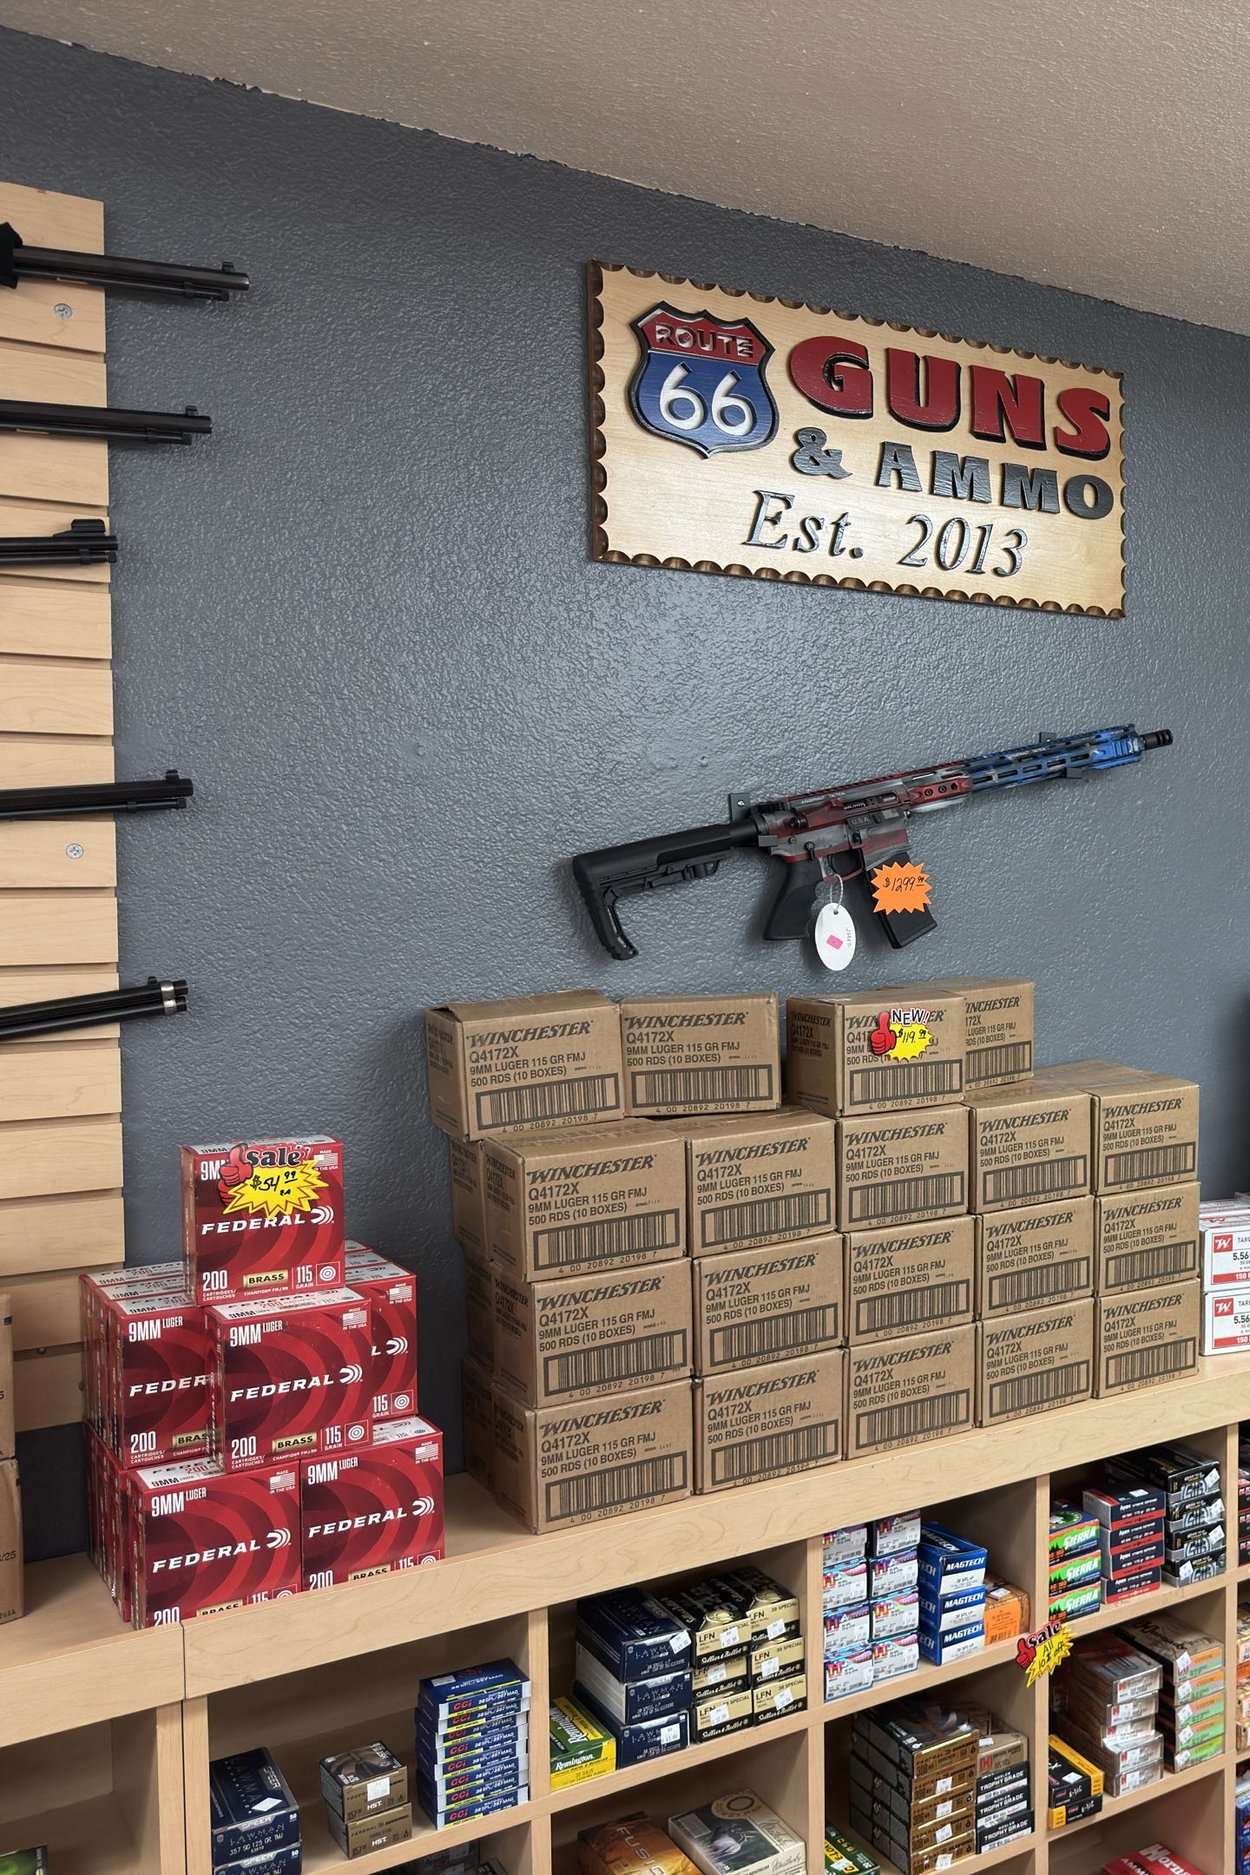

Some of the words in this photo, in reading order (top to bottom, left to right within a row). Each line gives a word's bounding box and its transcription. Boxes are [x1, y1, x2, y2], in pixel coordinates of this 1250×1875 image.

[655, 322, 754, 358] ROUTE
[660, 363, 752, 435] 66
[790, 336, 1110, 460] GUNS
[792, 427, 852, 480] &
[877, 441, 1114, 519] AMMO
[743, 490, 864, 558] Est.
[899, 514, 1028, 577] 2013
[966, 997, 1020, 1013] INCHESTER
[625, 1012, 746, 1029] WINCHESTER
[892, 1008, 930, 1025] NEW!
[466, 1021, 592, 1048] WINCHESTER
[627, 1031, 674, 1043] Q4172X
[469, 1046, 519, 1063] Q4172X
[627, 1046, 648, 1054] 9MM
[651, 1045, 684, 1053] LUGER
[721, 1042, 740, 1050] FMJ
[646, 1057, 666, 1065] RDS
[669, 1056, 682, 1065] (10
[685, 1053, 720, 1063] BOXES)
[1102, 1098, 1182, 1119] WINCHESTER
[979, 1109, 1070, 1133] WINCHESTER
[1103, 1118, 1135, 1131] Q4172X
[845, 1123, 945, 1146] WINCHESTER
[247, 1148, 301, 1167] sale
[695, 1138, 809, 1167] WINCHESTER
[846, 1145, 886, 1160] Q4172X
[201, 1160, 222, 1181] 9M
[527, 1155, 654, 1185] WINCHESTER
[529, 1182, 579, 1200] Q4172X
[1103, 1197, 1182, 1221] WINCHESTER
[202, 1213, 305, 1235] FEDERAL
[985, 1211, 1073, 1238] WINCHESTER
[853, 1231, 951, 1259] WINCHESTER
[986, 1235, 1021, 1251] Q4172X
[203, 1270, 228, 1291] 200
[249, 1273, 285, 1284] BRASS
[297, 1265, 313, 1283] 115
[704, 1253, 817, 1286] WINCHESTER
[1236, 1272, 1247, 1280] 150
[537, 1277, 662, 1312] WINCHESTER
[539, 1307, 589, 1327] Q4172X
[1103, 1294, 1182, 1320] WINCHESTER
[129, 1319, 161, 1342] 9MM
[162, 1316, 183, 1328] LUGER
[229, 1324, 262, 1347] 9MM
[263, 1320, 283, 1333] LUGER
[985, 1315, 1073, 1346] WINCHESTER
[1104, 1317, 1135, 1332] Q4172X
[852, 1341, 952, 1373] WINCHESTER
[230, 1375, 334, 1402] FEDERAL
[705, 1371, 818, 1407] WINCHESTER
[854, 1369, 893, 1387] Q4172X
[373, 1395, 388, 1413] 115
[707, 1401, 752, 1421] Q4172X
[539, 1399, 663, 1438] WINCHESTER
[131, 1431, 156, 1454] 200
[178, 1432, 208, 1445] BRAS
[277, 1435, 313, 1449] BRASS
[325, 1426, 341, 1444] 115
[231, 1436, 257, 1459] 200
[308, 1460, 338, 1486] 9MM
[339, 1457, 358, 1471] LUGER
[151, 1491, 184, 1518] 9MM
[185, 1487, 206, 1501] LUGER
[308, 1507, 407, 1538] FEDERAL
[1063, 1528, 1097, 1550] SIERRA
[152, 1540, 261, 1573] FEDERAL
[945, 1556, 985, 1571] MAGTECH
[310, 1570, 334, 1590] 200
[1066, 1559, 1098, 1581] SIERRA
[944, 1592, 984, 1609] MAGTECH
[1065, 1590, 1099, 1612] SIERRA
[944, 1624, 983, 1643] MAGTECH
[1029, 1621, 1060, 1647] sale
[756, 1690, 772, 1701] LFN
[984, 1829, 1008, 1841] TROPHY
[1010, 1820, 1029, 1831] GRADE
